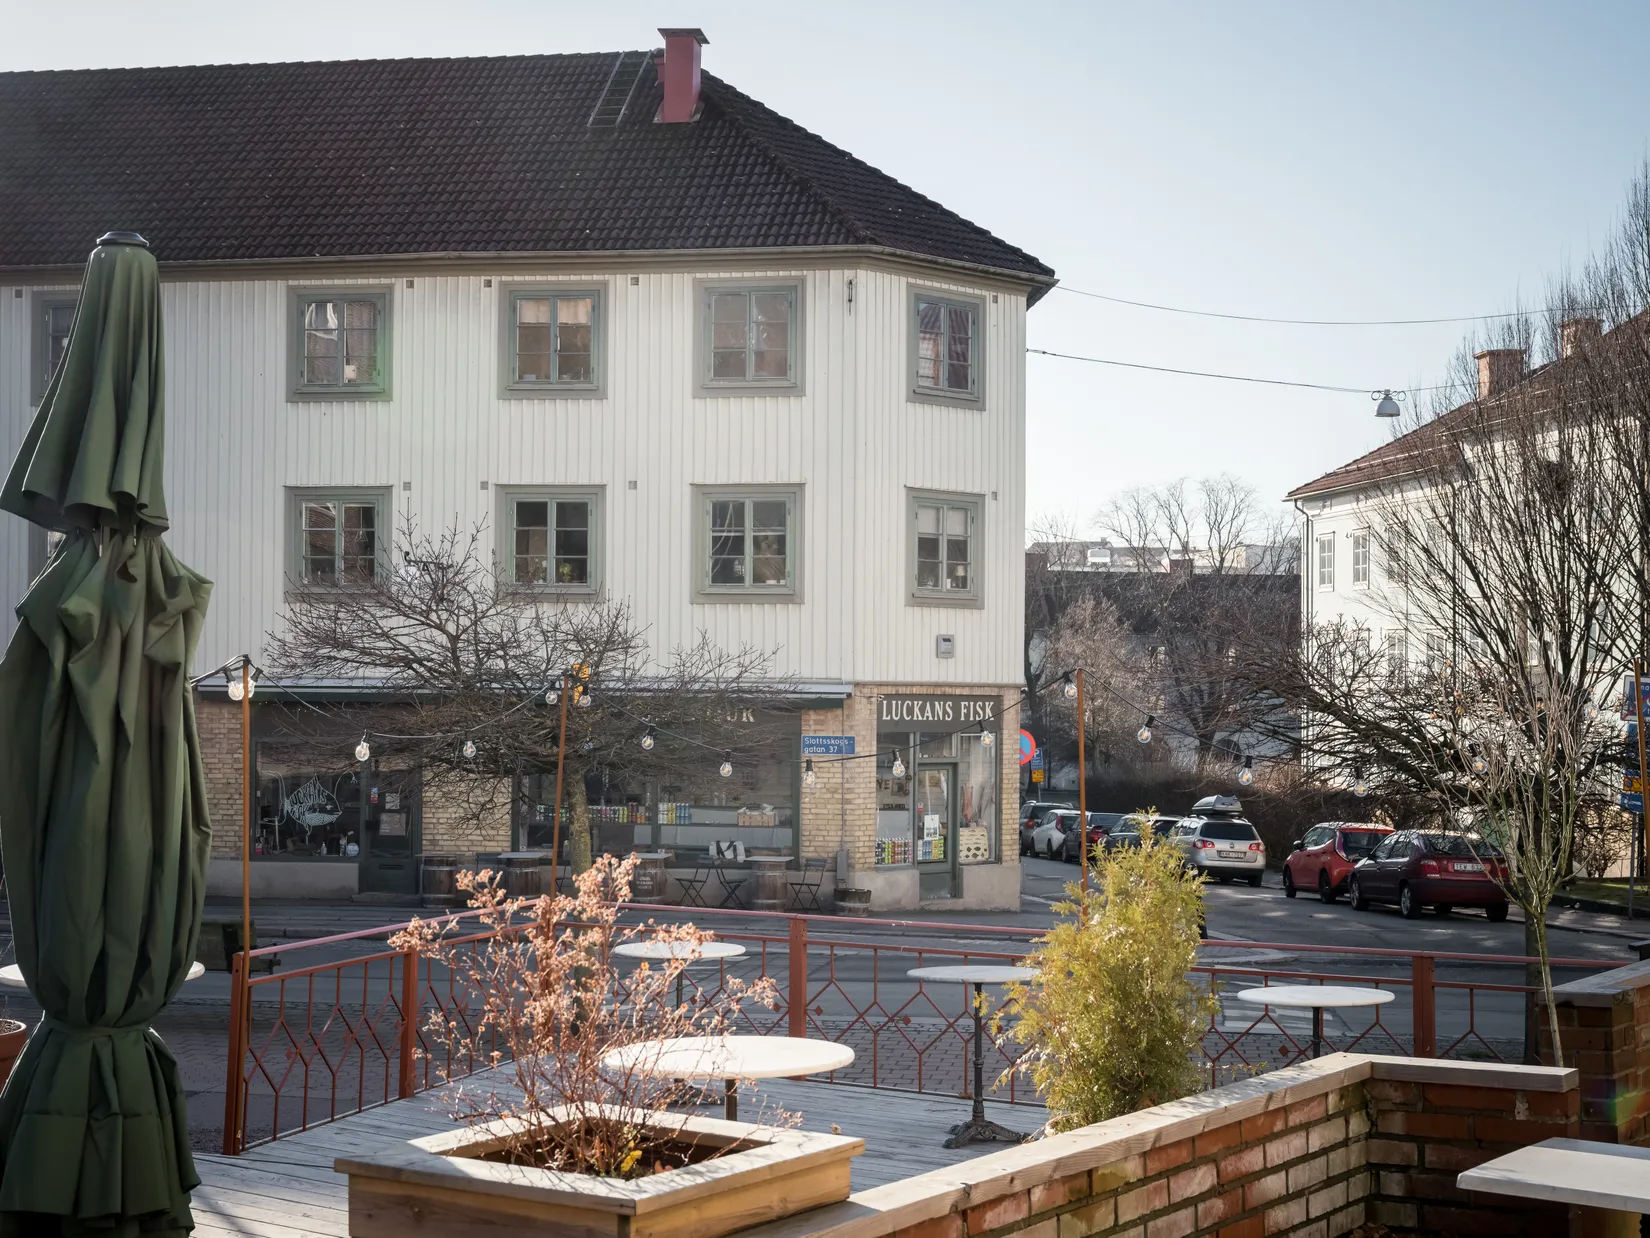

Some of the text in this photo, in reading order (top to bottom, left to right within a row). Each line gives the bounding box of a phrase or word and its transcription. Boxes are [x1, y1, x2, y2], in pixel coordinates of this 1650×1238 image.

[882, 700, 995, 721] LUCKANS FISK
[804, 746, 826, 754] gatan
